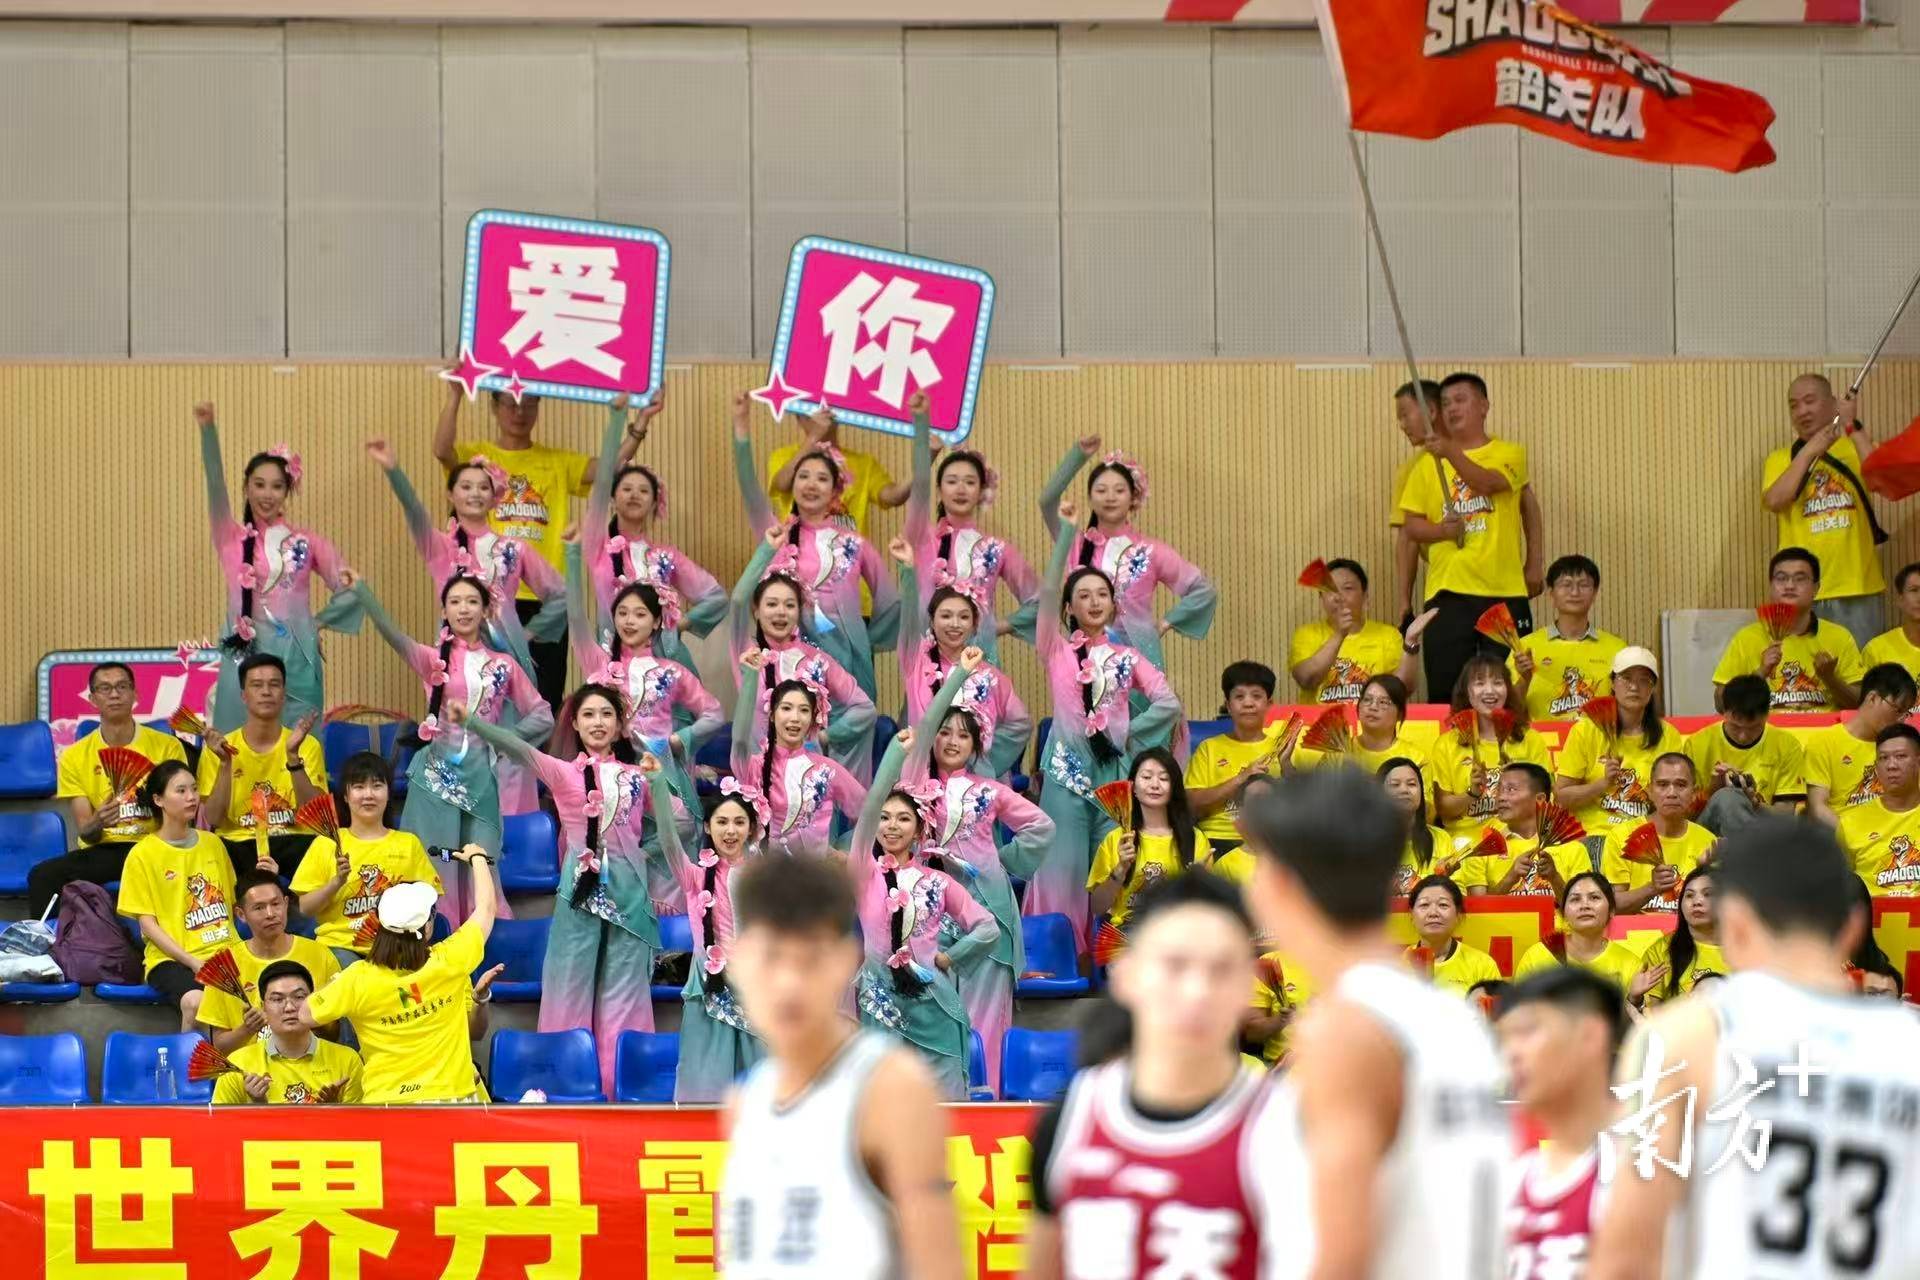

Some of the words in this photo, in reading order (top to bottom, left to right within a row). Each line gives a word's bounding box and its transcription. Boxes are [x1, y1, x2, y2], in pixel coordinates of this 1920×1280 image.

[1495, 58, 1646, 140] 韶关队
[500, 242, 627, 381] 爱
[819, 271, 955, 409] 你
[185, 902, 228, 929] SHAOGU
[1877, 864, 1920, 886] SHAOGU
[1750, 1124, 1892, 1276] 33
